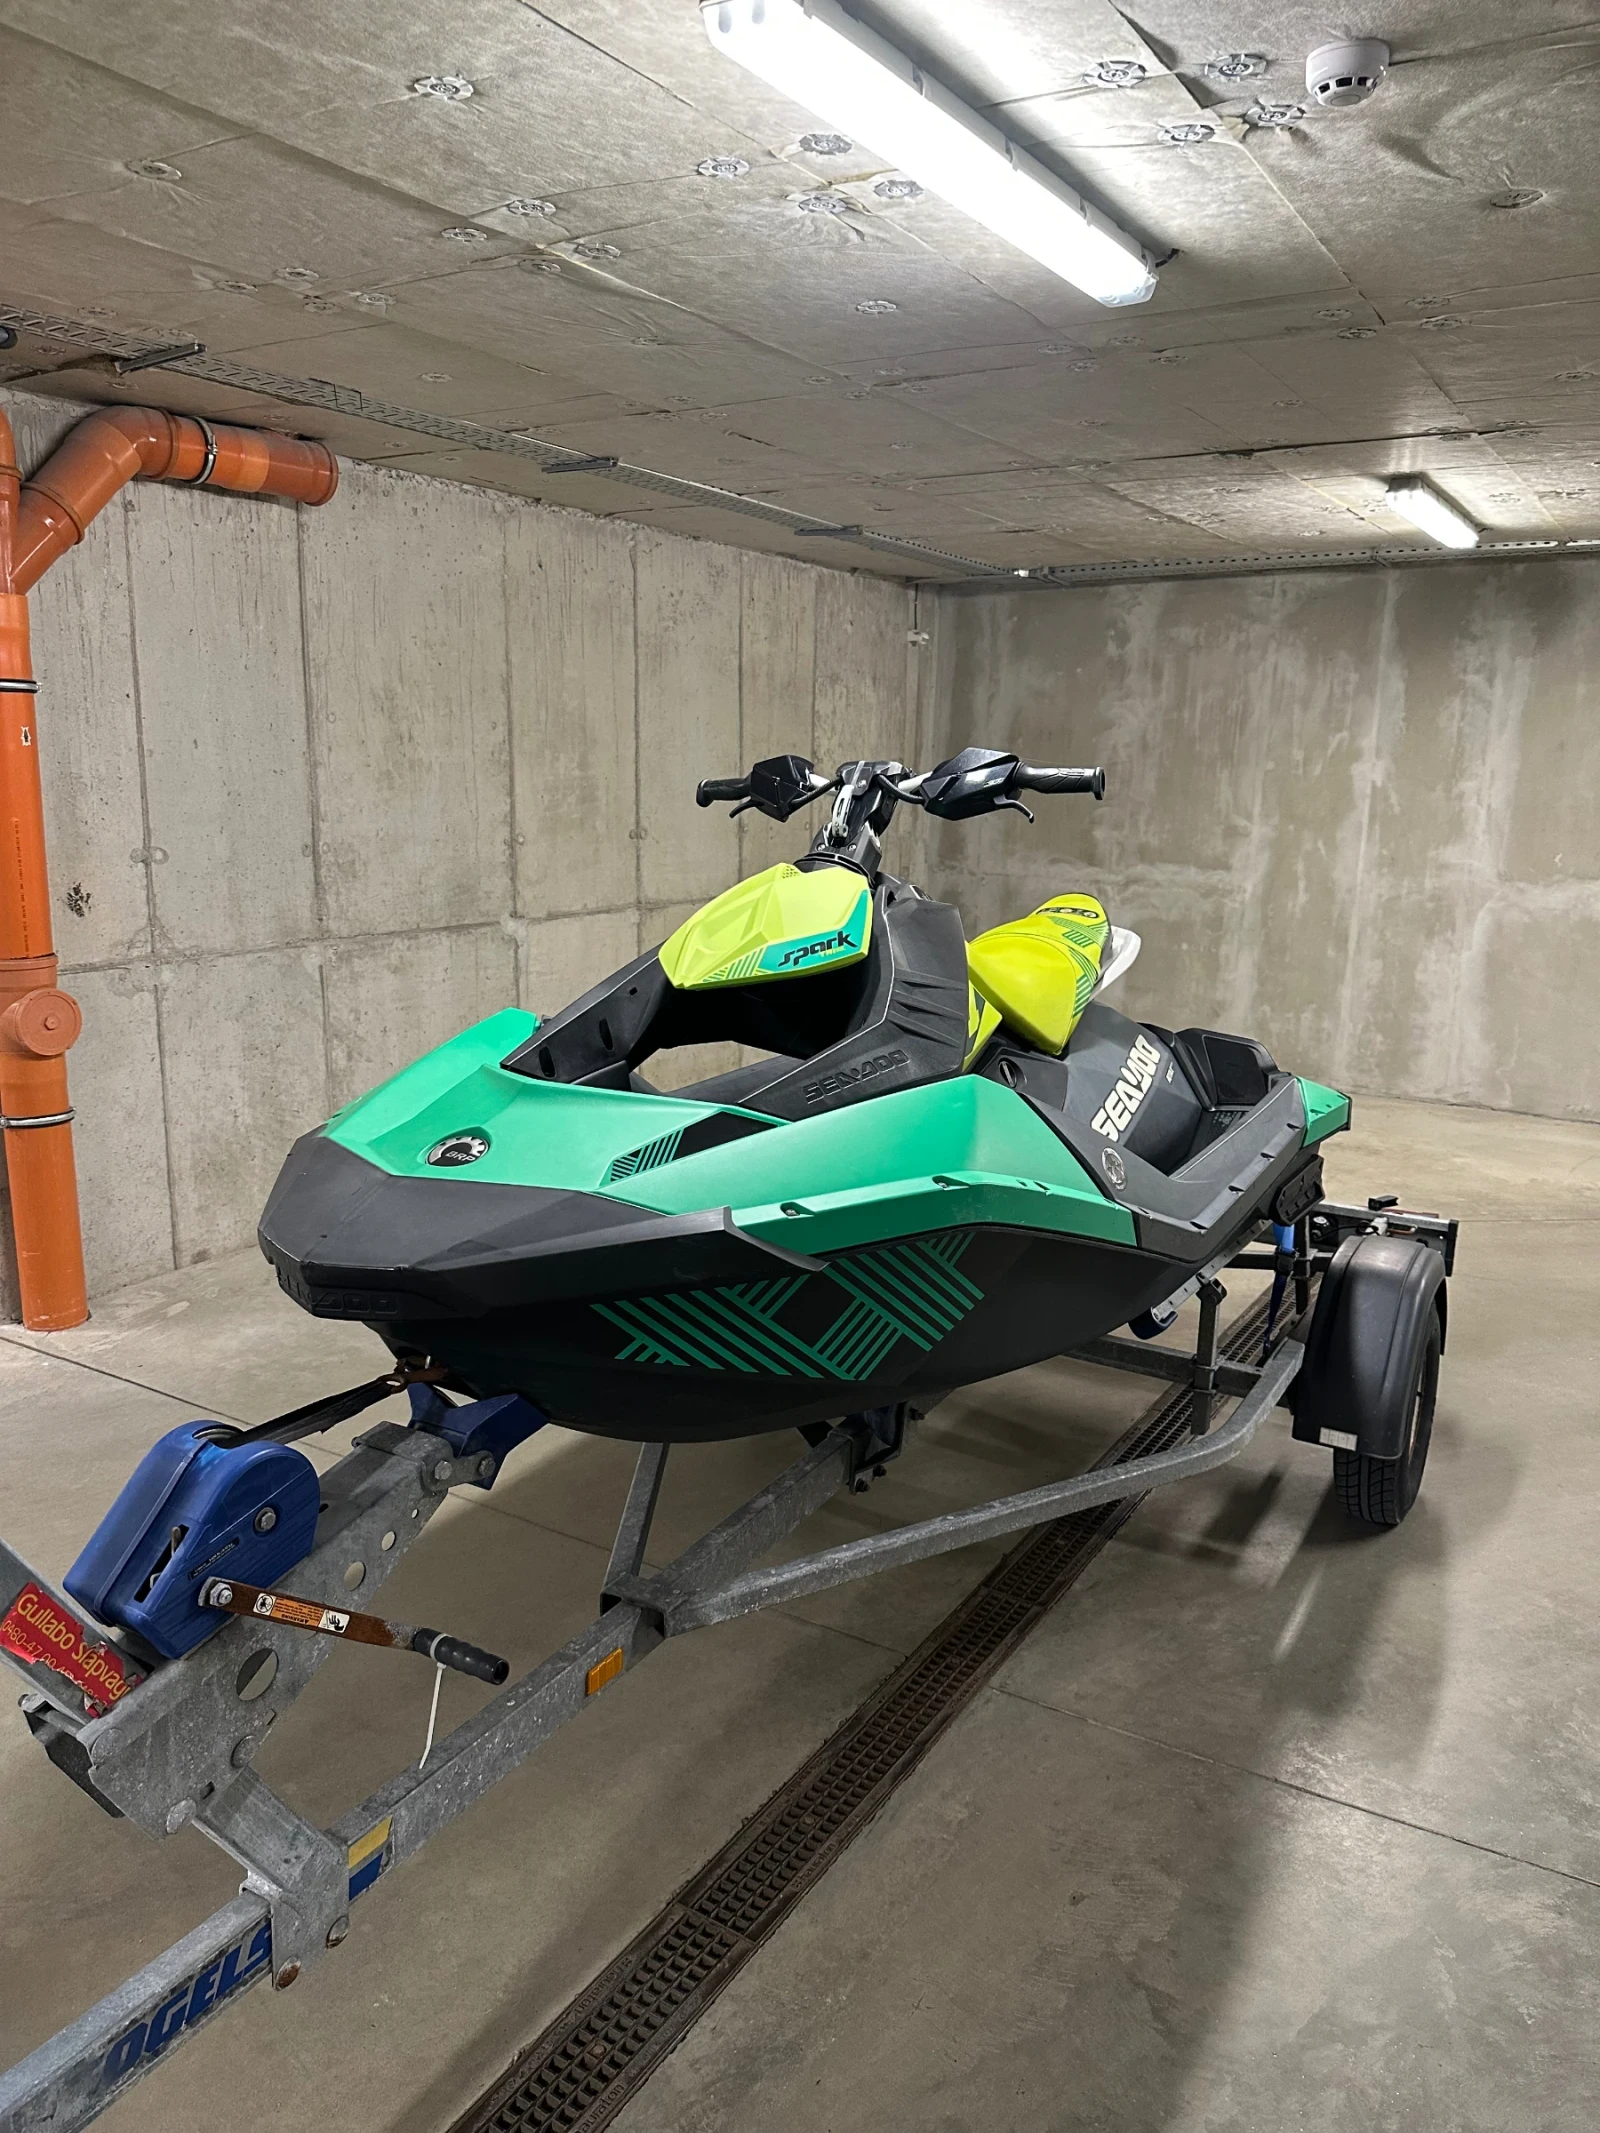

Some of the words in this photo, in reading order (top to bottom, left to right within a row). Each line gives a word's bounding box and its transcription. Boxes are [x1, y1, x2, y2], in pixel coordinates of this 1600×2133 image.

[445, 1150, 476, 1161] BRP
[2, 1620, 43, 1657] 0480-47
[17, 1593, 76, 1650] Gullabo
